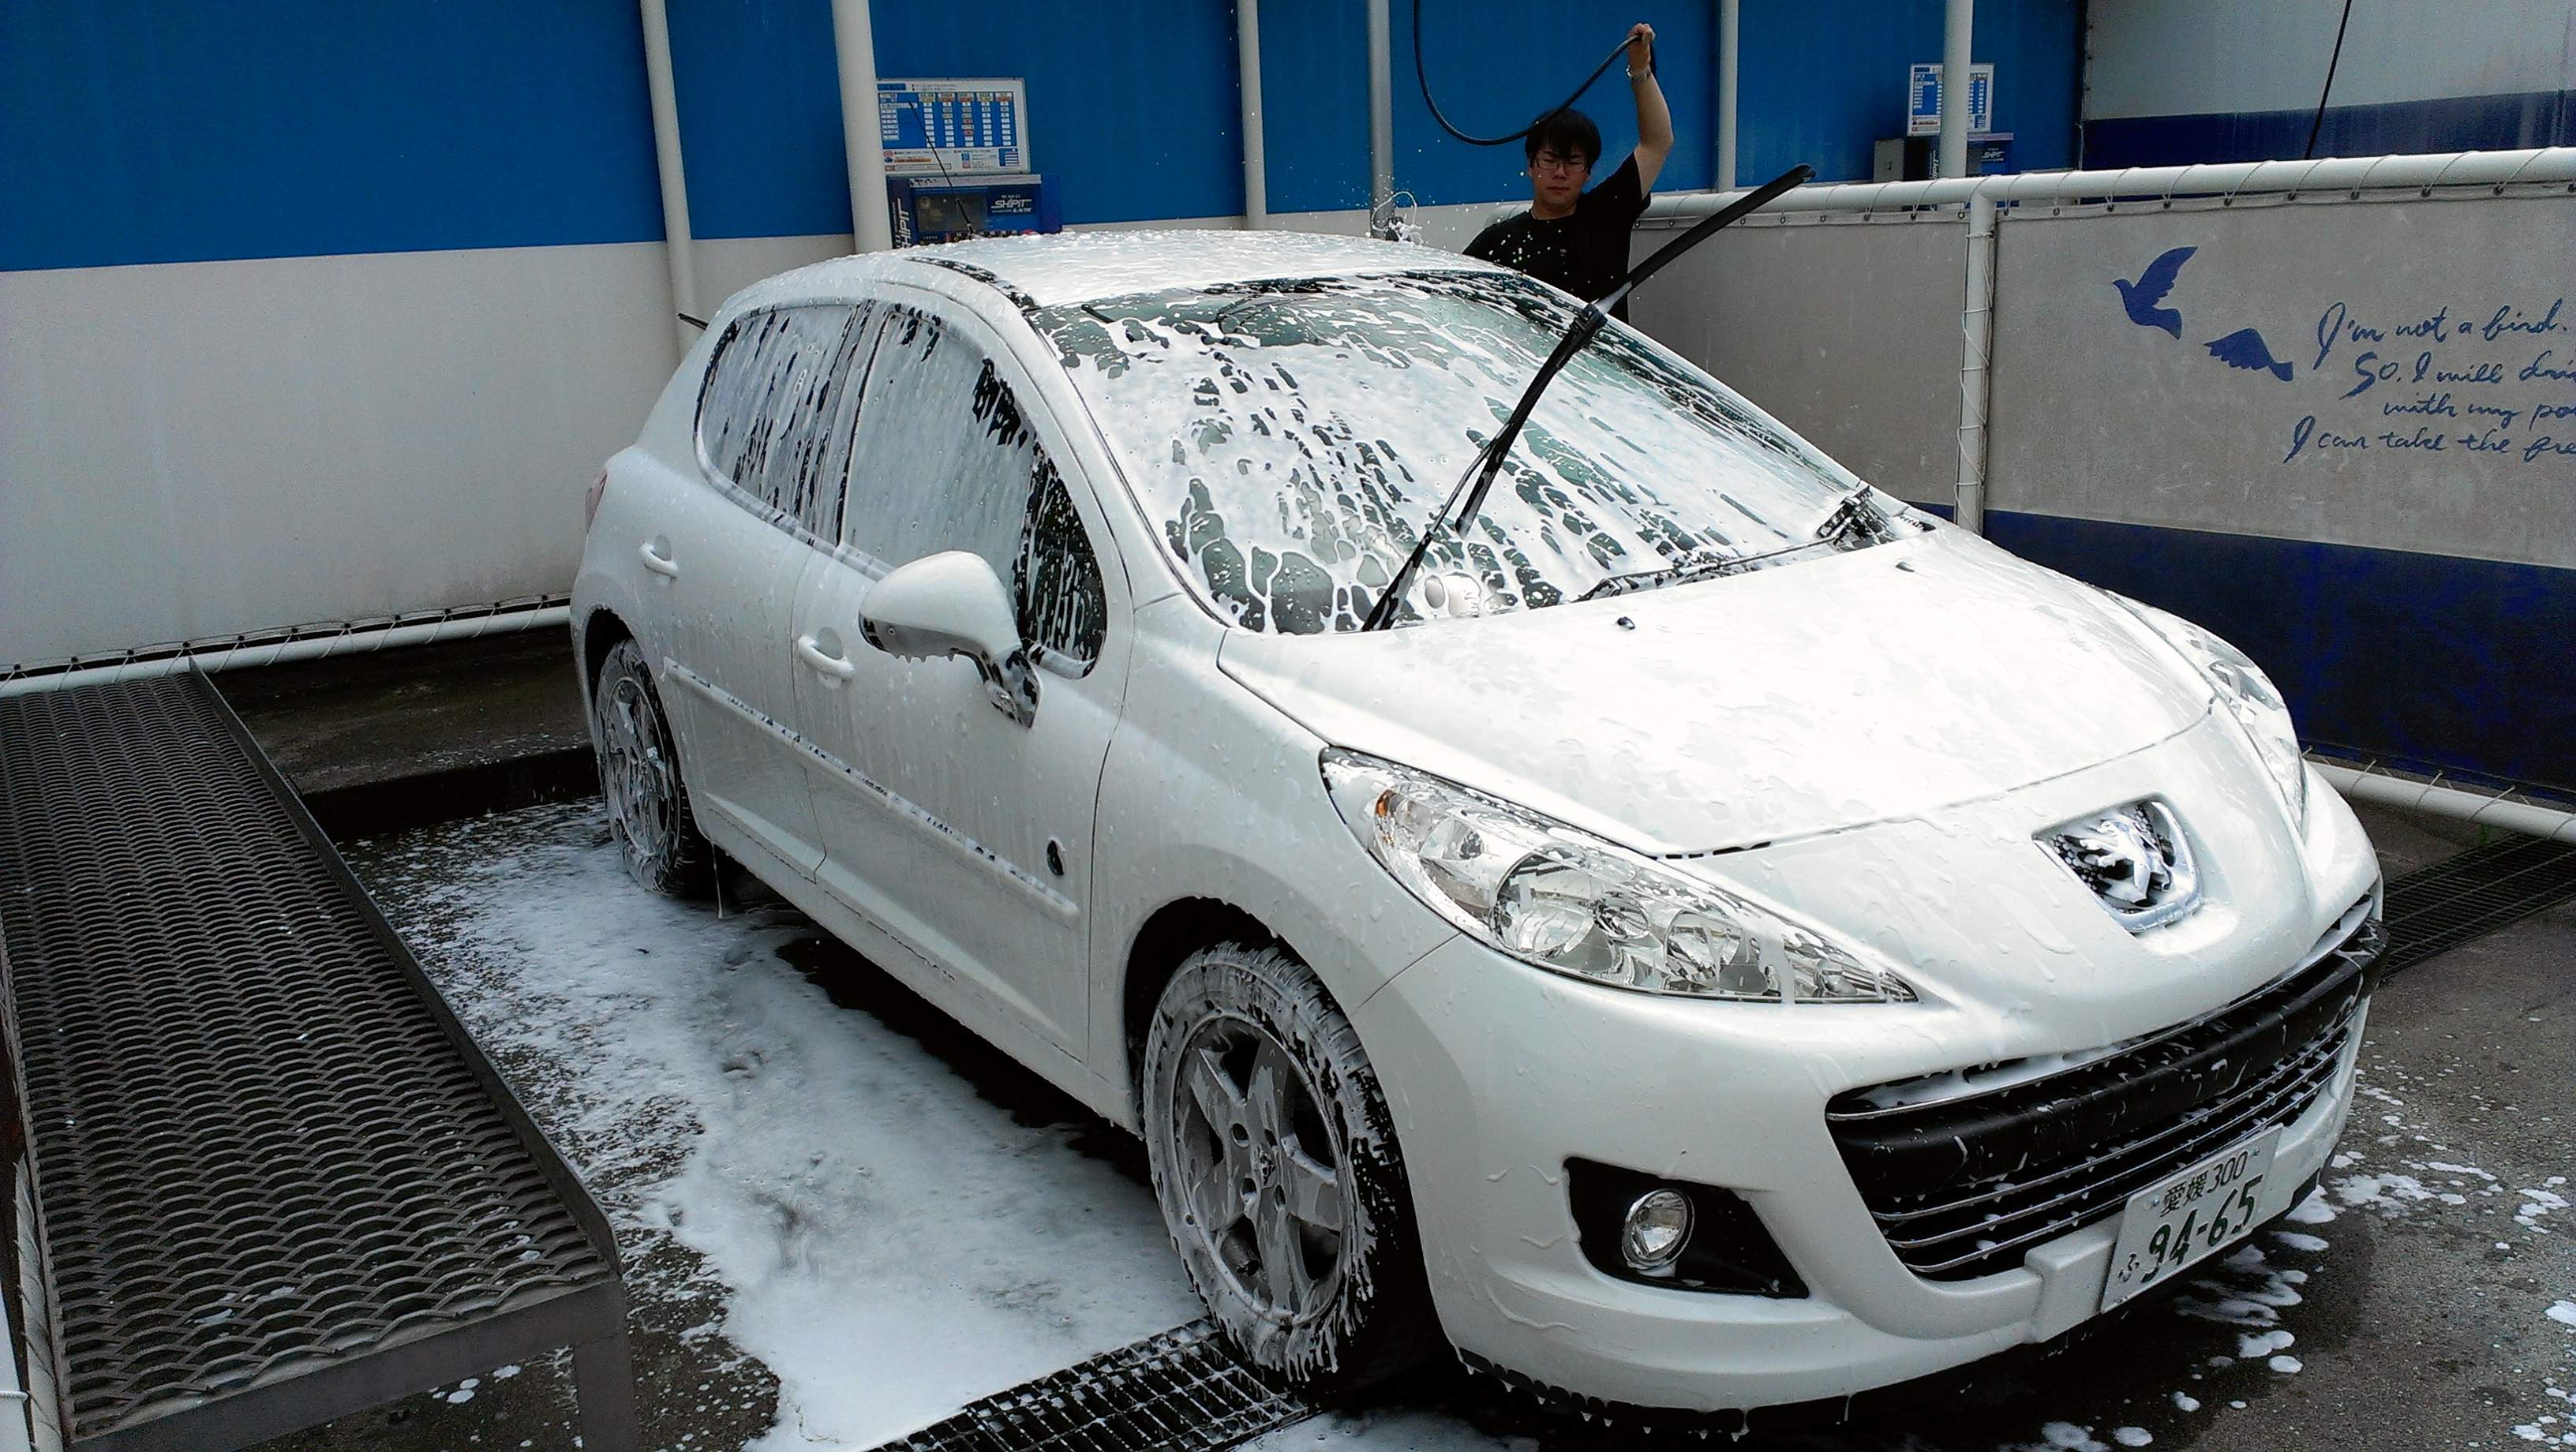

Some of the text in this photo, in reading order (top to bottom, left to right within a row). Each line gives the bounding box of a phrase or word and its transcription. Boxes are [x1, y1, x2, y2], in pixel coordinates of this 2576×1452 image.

[2313, 298, 2567, 370] I'm not a bird.
[2412, 351, 2432, 384] I
[2437, 364, 2503, 384] will
[2384, 392, 2458, 418] with
[2468, 403, 2524, 428] my
[2283, 415, 2316, 464] I
[2318, 432, 2369, 450] can
[2379, 427, 2447, 451] take
[2457, 428, 2510, 453] the
[2160, 1151, 2248, 1217] 愛媛 300
[2117, 1174, 2263, 1283] ふ 94-65
